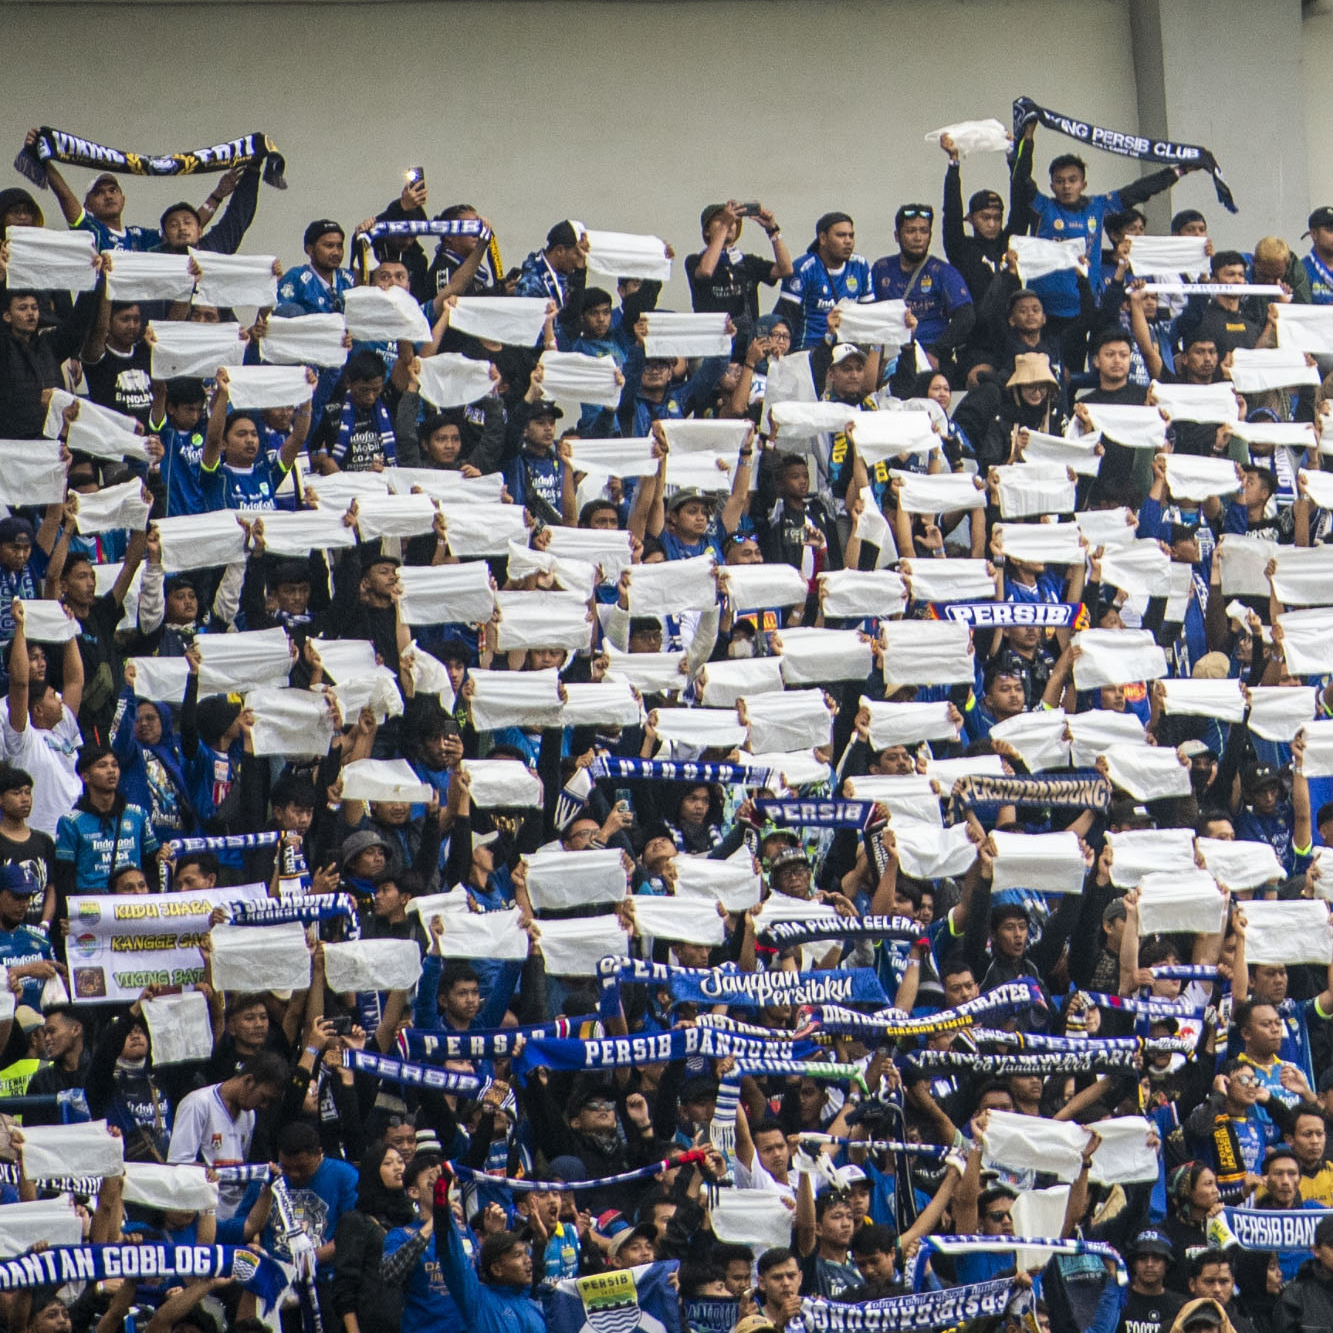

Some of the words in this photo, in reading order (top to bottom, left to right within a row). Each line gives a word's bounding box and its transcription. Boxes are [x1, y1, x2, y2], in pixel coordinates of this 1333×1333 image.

[1092, 127, 1150, 154] PERSIB
[1153, 141, 1201, 160] CLUB
[955, 603, 1069, 627] PERSIB
[764, 802, 863, 822] PERSIB
[169, 829, 278, 852] PERSIB
[113, 904, 159, 922] KUDU
[160, 898, 214, 918] JUARA
[805, 918, 861, 938] PUNYA
[863, 915, 922, 935] SELERA
[110, 933, 176, 954] KANGGE
[113, 969, 170, 989] VIKING
[758, 976, 854, 1007] Persibku
[956, 982, 1031, 1016] PIRATES
[936, 1014, 974, 1032] TIMUR
[584, 1034, 673, 1066] PERSIB
[684, 1027, 794, 1060] BANDUNG
[355, 1050, 481, 1090] PERSIB
[1232, 1213, 1283, 1246] PERSIB
[581, 1273, 629, 1292] PERSIB
